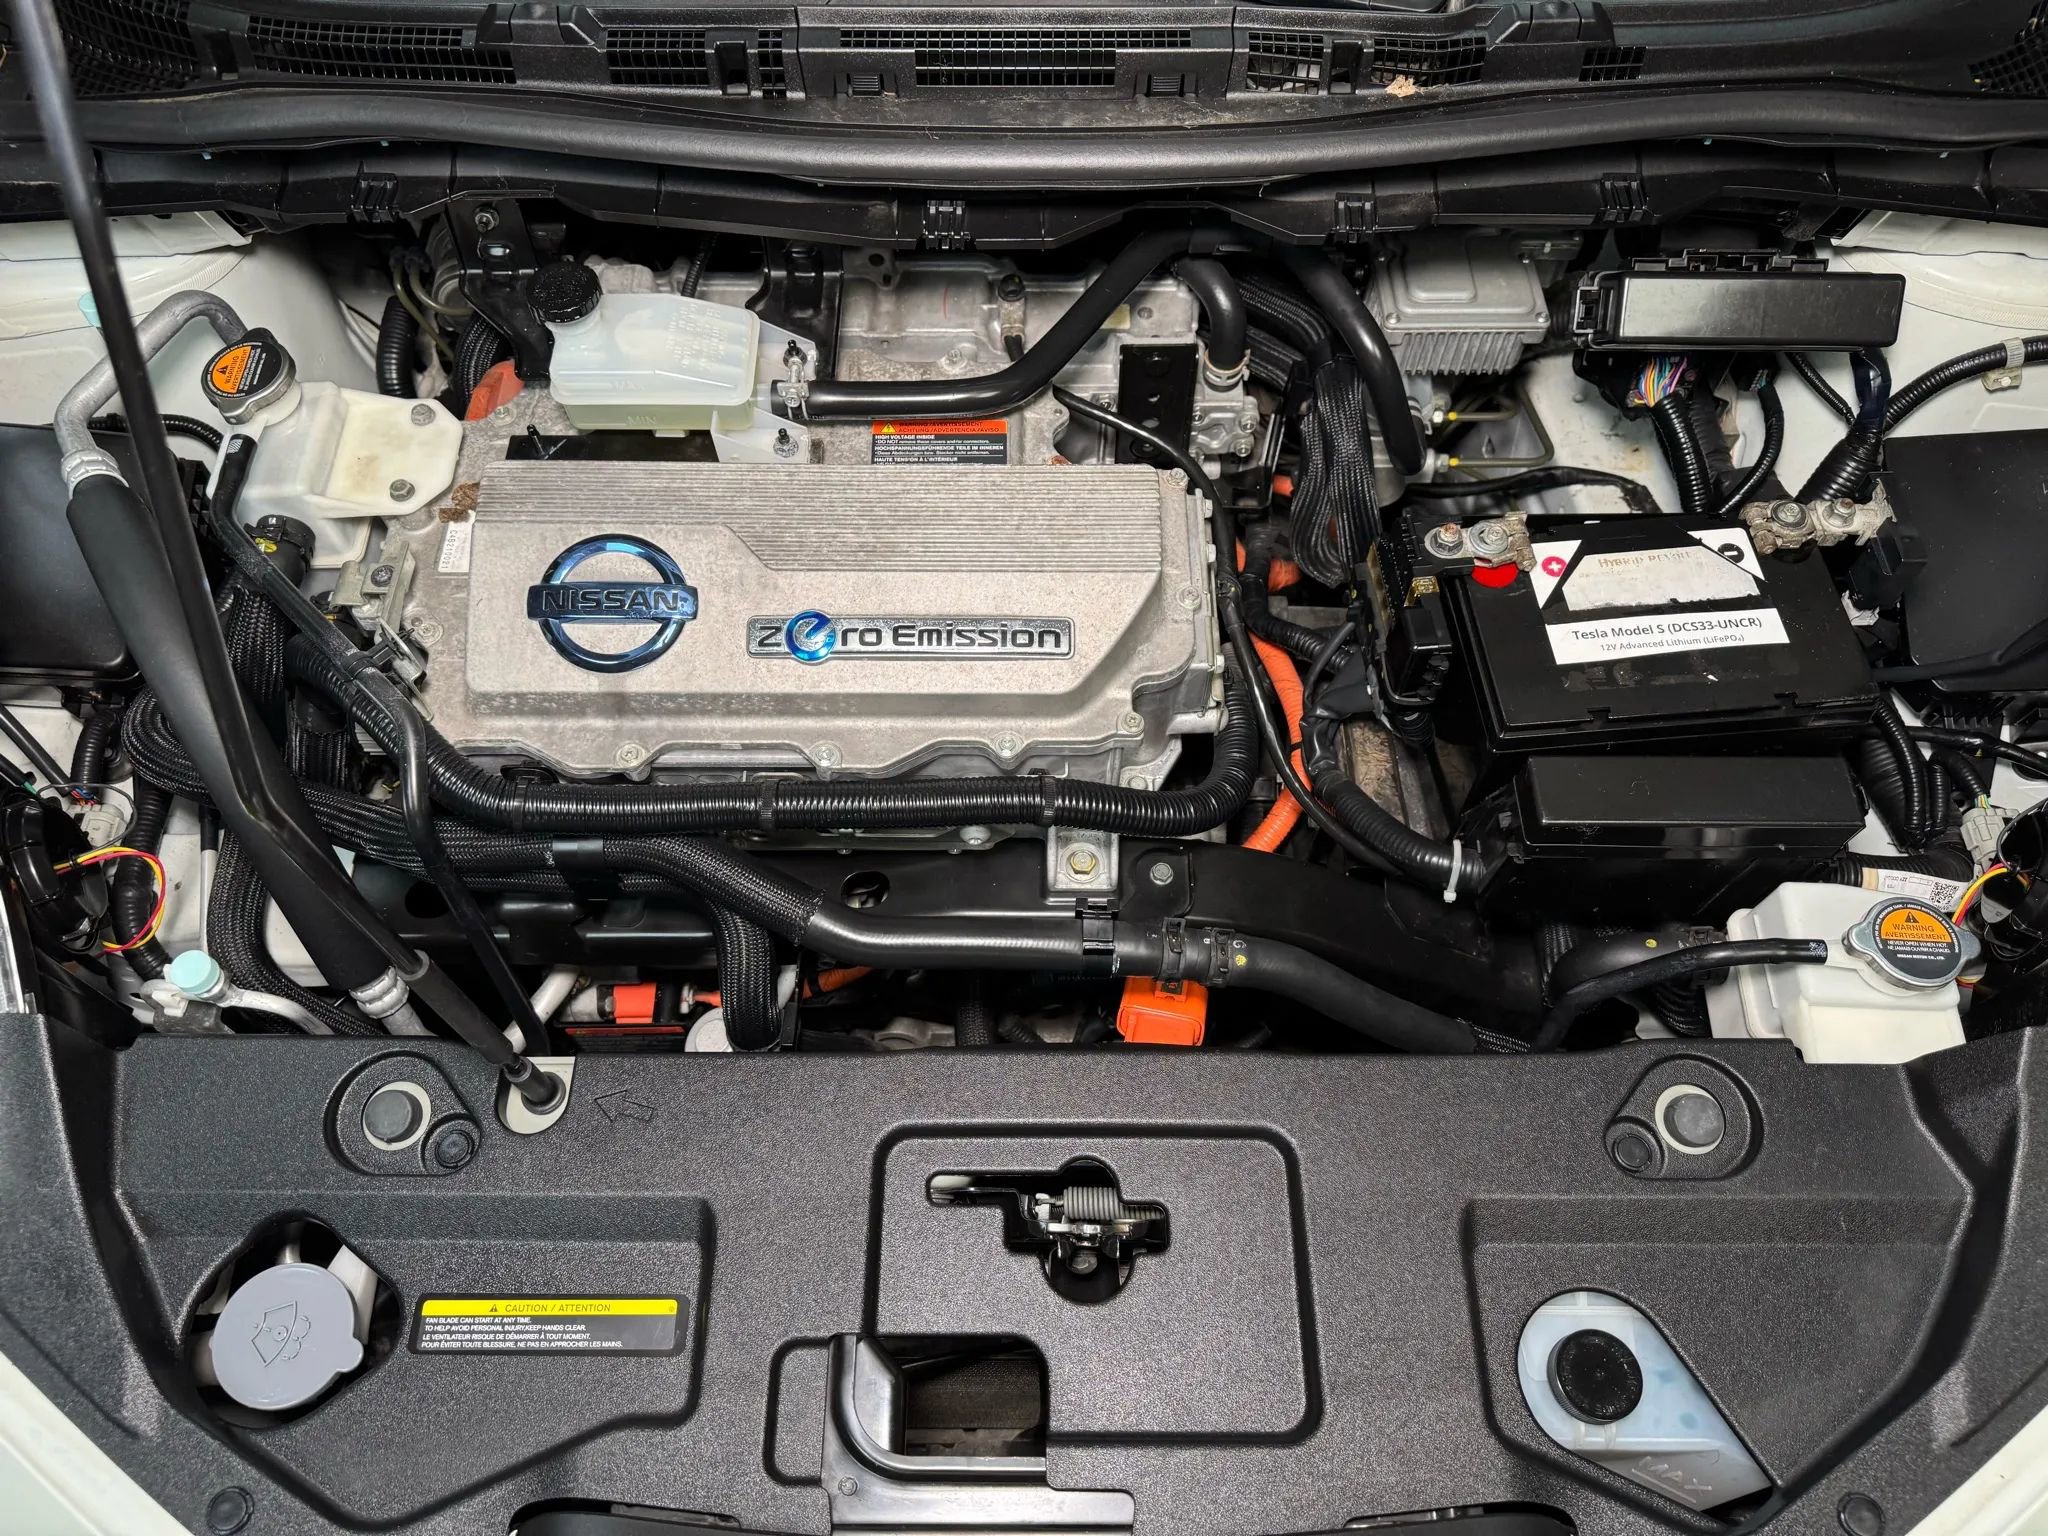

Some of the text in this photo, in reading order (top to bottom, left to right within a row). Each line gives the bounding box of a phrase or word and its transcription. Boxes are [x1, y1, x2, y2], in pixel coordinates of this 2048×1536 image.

[625, 415, 657, 427] MIN
[542, 588, 680, 612] NISSAN
[1571, 617, 1762, 640] Tesla Model S (DCS33-UNCR)
[891, 621, 1062, 650] Emission
[1600, 643, 1617, 651] 12V
[1619, 639, 1664, 650] Advanced
[1666, 638, 1701, 647] Lithium
[1892, 923, 1935, 932] WARNING
[1885, 931, 1946, 940] AVERTISSEMENT
[505, 1303, 548, 1313] CAUTION
[559, 1303, 612, 1312] ATTENTION
[505, 1332, 540, 1340] DÉMARRER
[440, 1340, 462, 1348] ÉVITER
[1638, 1455, 1713, 1497] MAX
